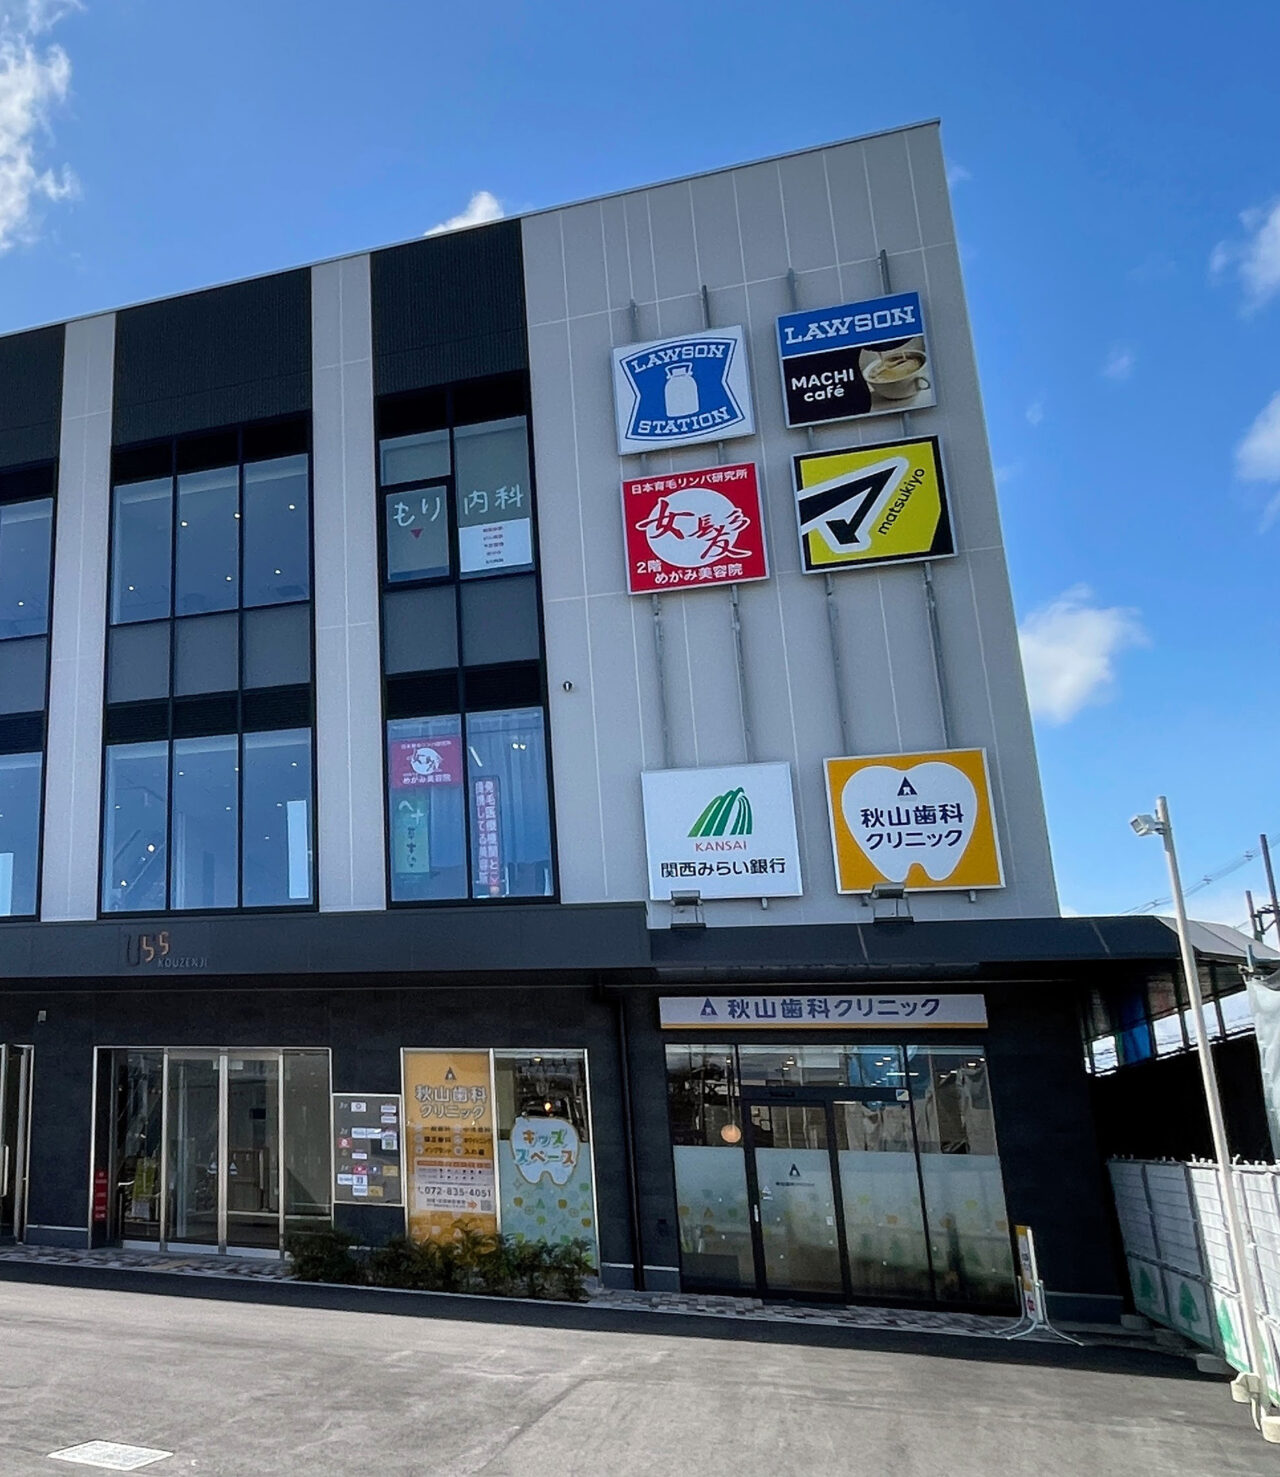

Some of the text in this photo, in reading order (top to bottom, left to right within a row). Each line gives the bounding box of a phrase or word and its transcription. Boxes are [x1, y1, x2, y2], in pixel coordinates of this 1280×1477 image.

[785, 306, 915, 344] LAWSON
[631, 344, 725, 373] LAWSON
[791, 368, 855, 391] MACHI
[804, 384, 845, 402] café
[638, 406, 730, 434] STATION
[393, 497, 440, 526] もり
[877, 466, 926, 536] matsukiyo
[636, 559, 662, 574] 2階
[654, 562, 744, 585] めがみ美容院
[860, 803, 964, 829] 秋山歯科
[695, 841, 747, 853] KANSAI
[865, 829, 963, 850] クリニック
[660, 858, 786, 879] 関西みらい銀行
[728, 997, 941, 1019] 秋山歯科クリニック
[415, 1084, 488, 1103] 秋山歯科
[420, 1104, 485, 1119] クリニック
[522, 1128, 567, 1147] キッズ
[516, 1149, 575, 1165] スペース
